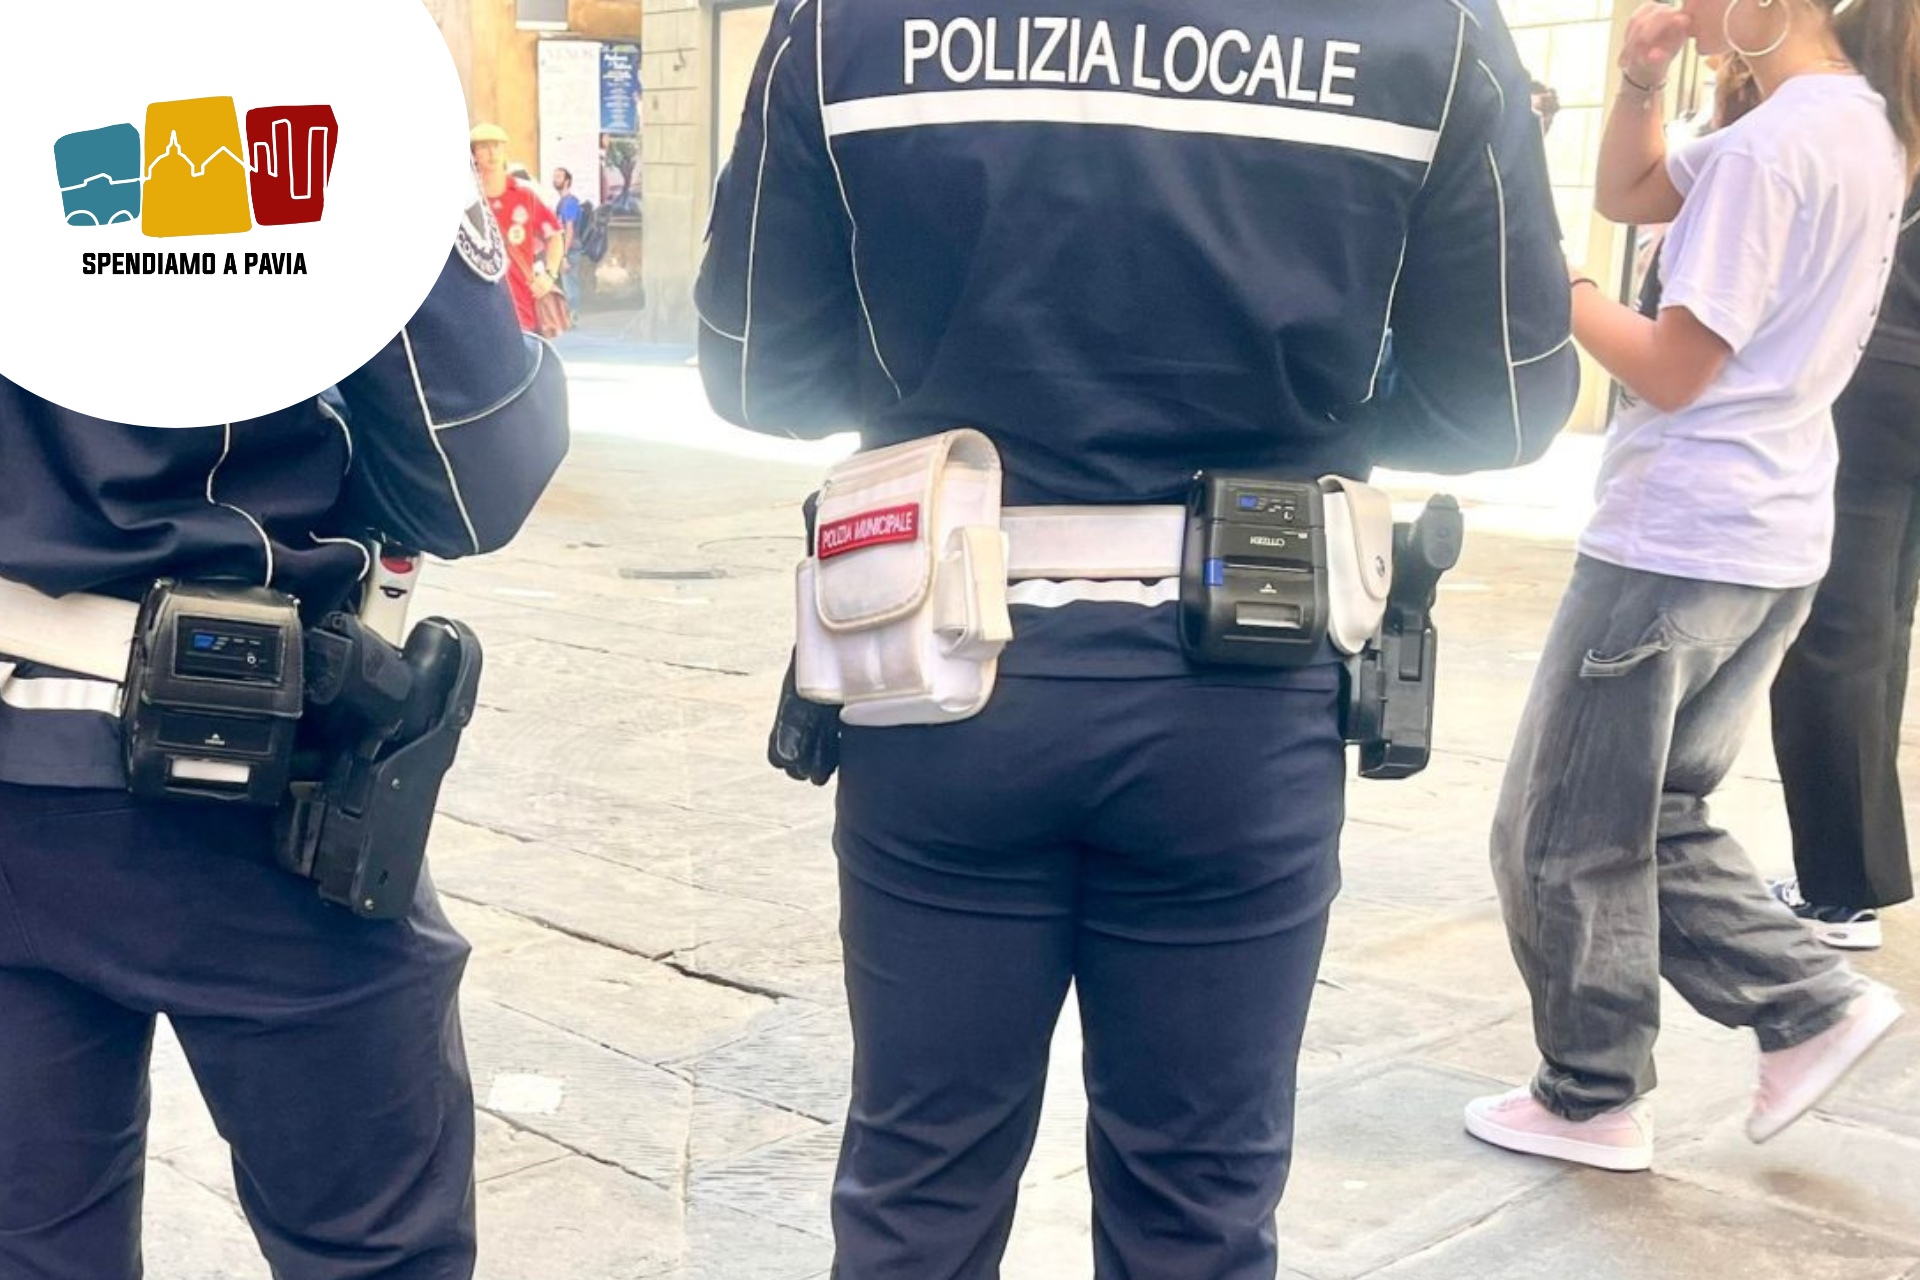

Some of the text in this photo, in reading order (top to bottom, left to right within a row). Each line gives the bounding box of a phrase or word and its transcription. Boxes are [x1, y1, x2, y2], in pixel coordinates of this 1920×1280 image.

[905, 17, 1361, 107] POLIZIA LOCALE
[822, 512, 912, 548] POLIZIA MUNICIPALE
